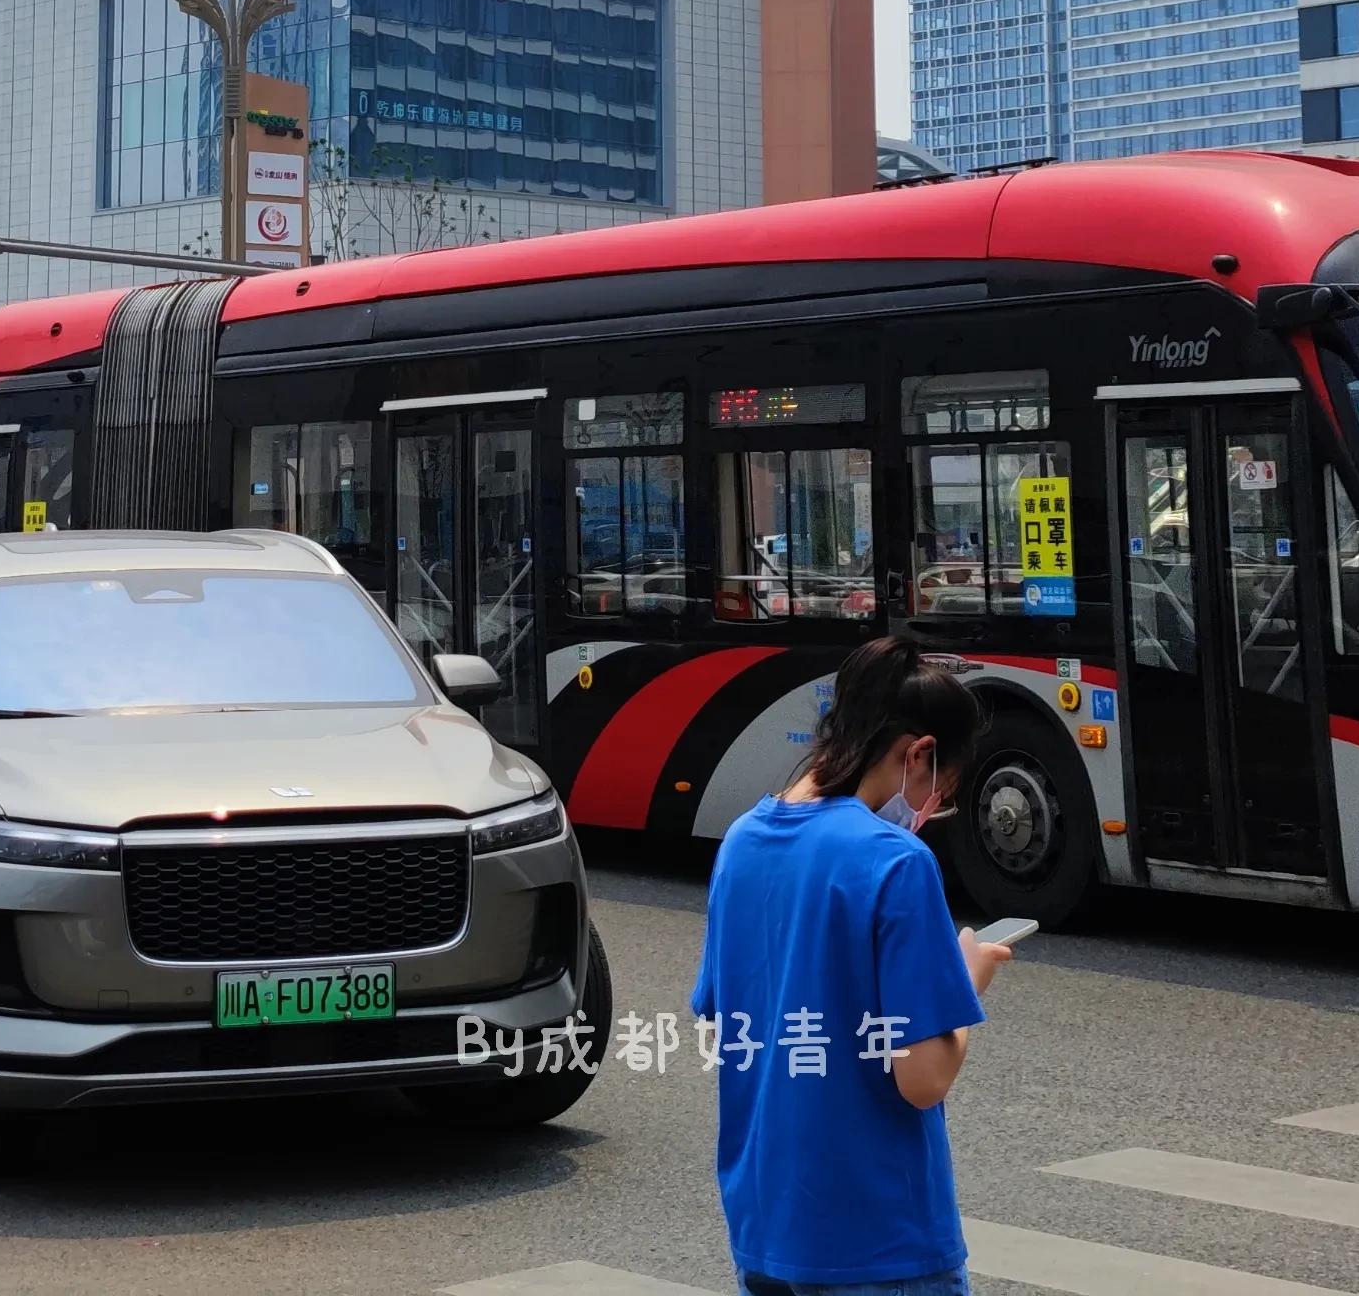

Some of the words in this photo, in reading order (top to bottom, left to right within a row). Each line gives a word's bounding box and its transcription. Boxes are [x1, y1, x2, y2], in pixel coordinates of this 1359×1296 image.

[1129, 334, 1210, 365] Yinlong
[1025, 497, 1065, 513] 请佩戴
[1025, 518, 1067, 546] 口罩
[1028, 551, 1068, 571] 乘车
